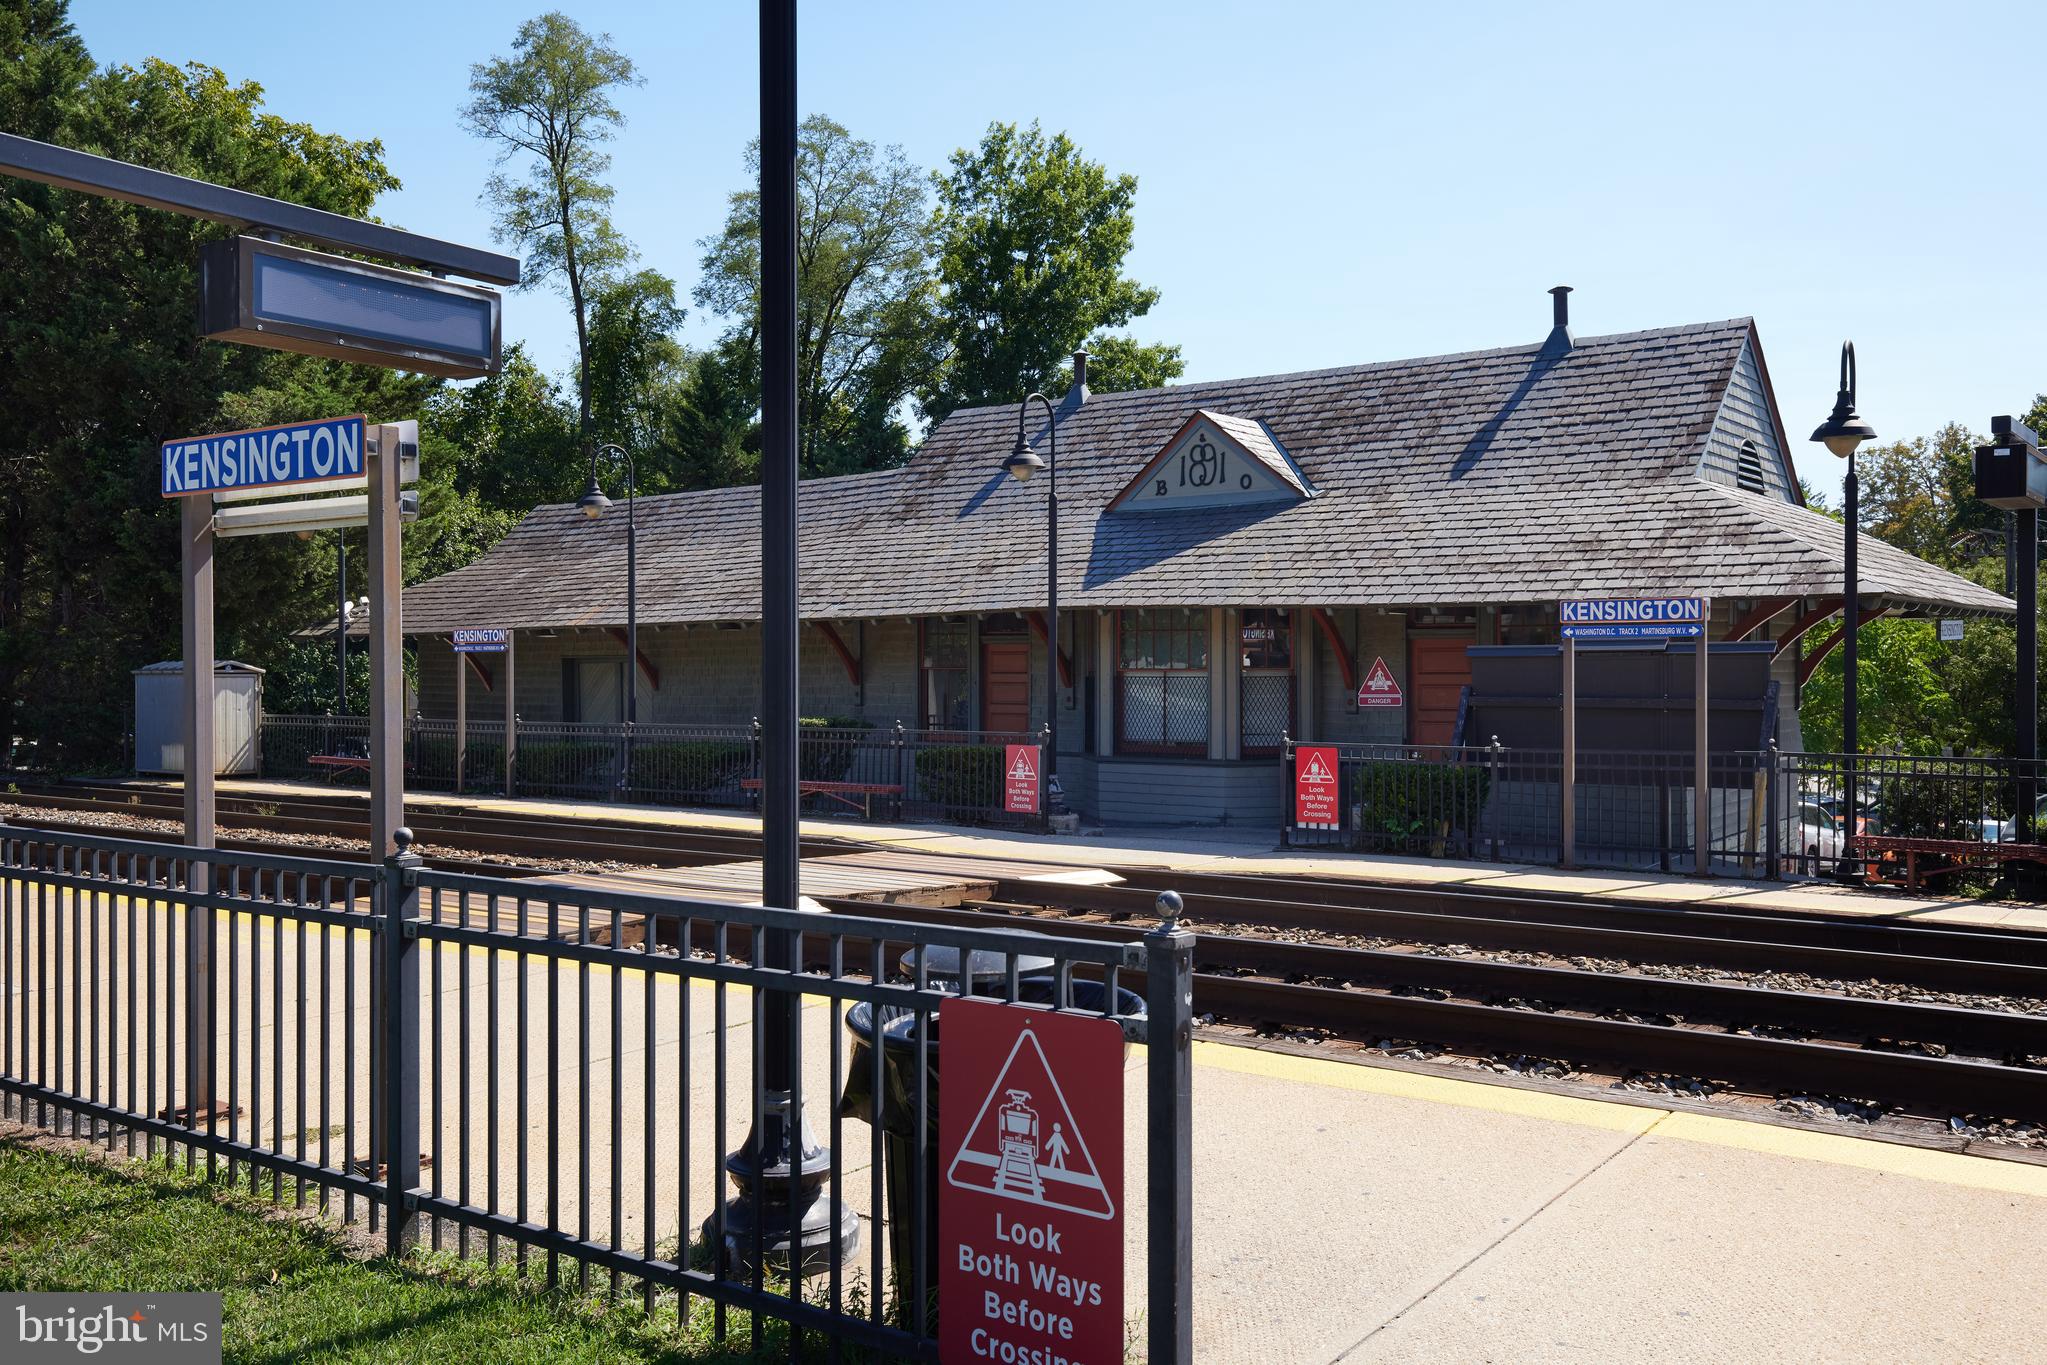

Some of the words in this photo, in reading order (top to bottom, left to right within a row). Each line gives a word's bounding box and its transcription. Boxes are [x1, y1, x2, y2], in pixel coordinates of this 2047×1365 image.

[166, 423, 358, 492] KENSINGTON
[1155, 480, 1168, 496] B
[1180, 443, 1226, 487] 1891
[1563, 599, 1699, 621] KENSINGTON
[454, 629, 504, 642] KENSINGTON
[1575, 628, 1606, 636] WASHINGTON
[1641, 627, 1676, 635] MARTINSBURG
[1304, 811, 1331, 819] Crossing
[996, 1213, 1061, 1254] Look
[959, 1244, 1020, 1284] Both
[1029, 1261, 1102, 1306] Ways
[984, 1290, 1074, 1340] Before
[971, 1328, 1084, 1365] Crossin
